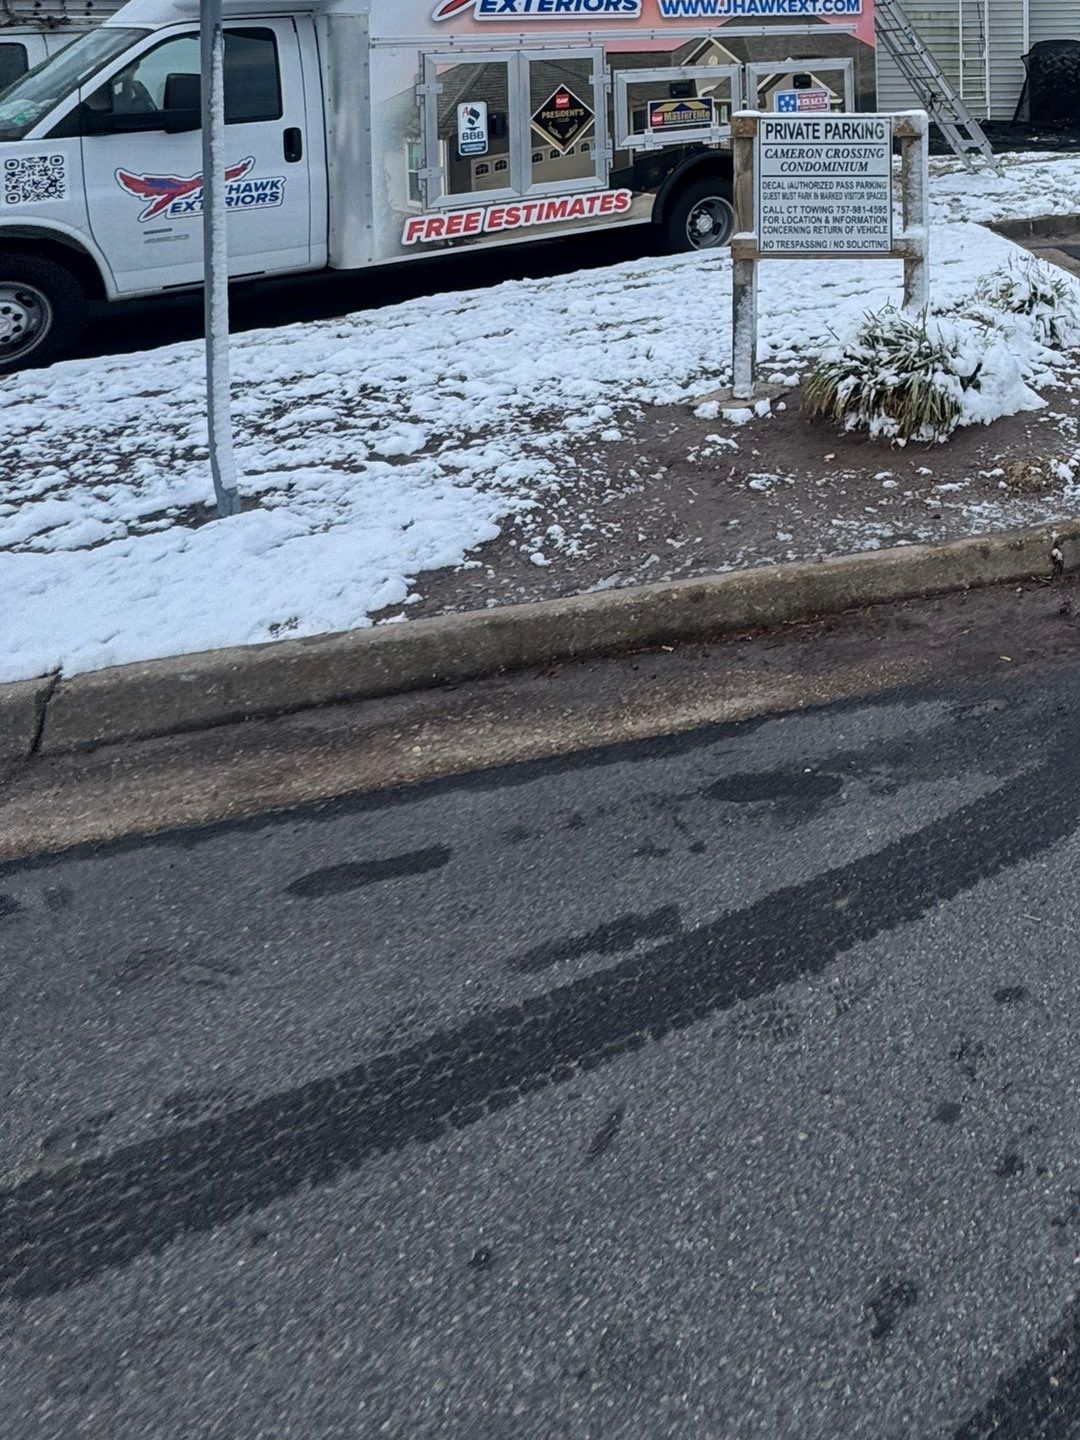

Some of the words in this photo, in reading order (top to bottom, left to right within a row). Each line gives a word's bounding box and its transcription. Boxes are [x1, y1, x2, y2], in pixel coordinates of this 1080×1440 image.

[462, 131, 485, 141] BBB
[765, 122, 821, 140] PRIVATE
[824, 122, 885, 140] PARKING
[764, 148, 823, 159] CAMERON
[825, 148, 885, 159] CROSSING
[780, 161, 869, 173] CONDOMINIUM
[762, 181, 785, 190] DECAL
[835, 181, 854, 190] PASS
[856, 181, 887, 190] PARKING
[762, 191, 780, 200] GUEST
[782, 191, 796, 200] MUST
[798, 191, 812, 200] PARK
[820, 191, 843, 200] MARKED
[844, 191, 865, 200] VISITOR
[866, 191, 887, 200] SPACES
[762, 205, 785, 214] CALL
[786, 205, 798, 214] CT
[800, 205, 834, 214] TOWING
[406, 212, 481, 242] FREE
[487, 192, 629, 229] ESTIMATES
[763, 215, 780, 224] FOR
[782, 215, 822, 224] LOCATION
[824, 215, 830, 224] &
[833, 215, 888, 224] INFORMATION
[762, 225, 811, 235] CONCERNING
[813, 225, 843, 235] RETURN
[844, 225, 854, 235] OF
[856, 225, 888, 235] VEHICLE
[763, 240, 774, 249] NO
[776, 240, 827, 249] TRESPASSING
[833, 240, 844, 249] NO
[846, 240, 888, 249] SOLICITING
